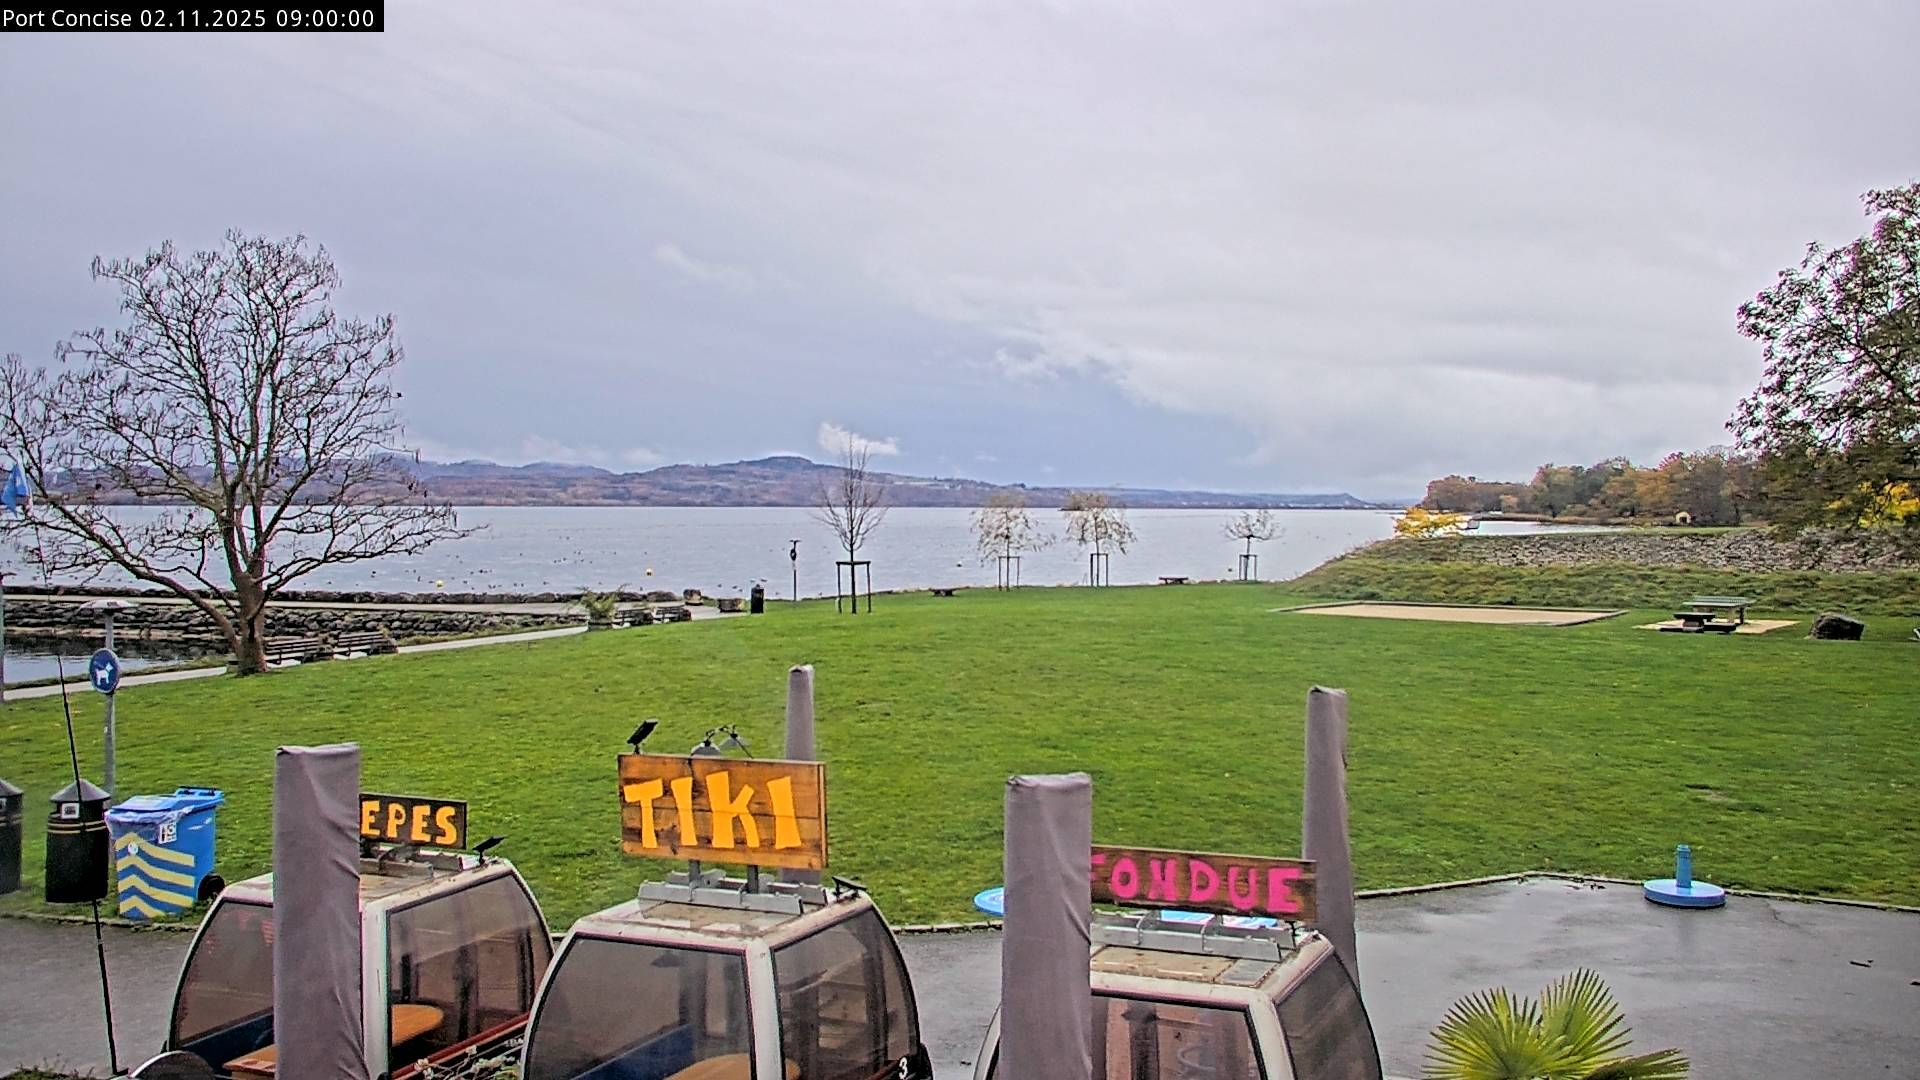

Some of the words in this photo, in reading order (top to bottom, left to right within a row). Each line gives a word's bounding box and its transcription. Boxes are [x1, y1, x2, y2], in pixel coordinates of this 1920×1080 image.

[360, 800, 457, 845] EPES
[623, 771, 802, 850] TIKI
[899, 1057, 908, 1080] 3
